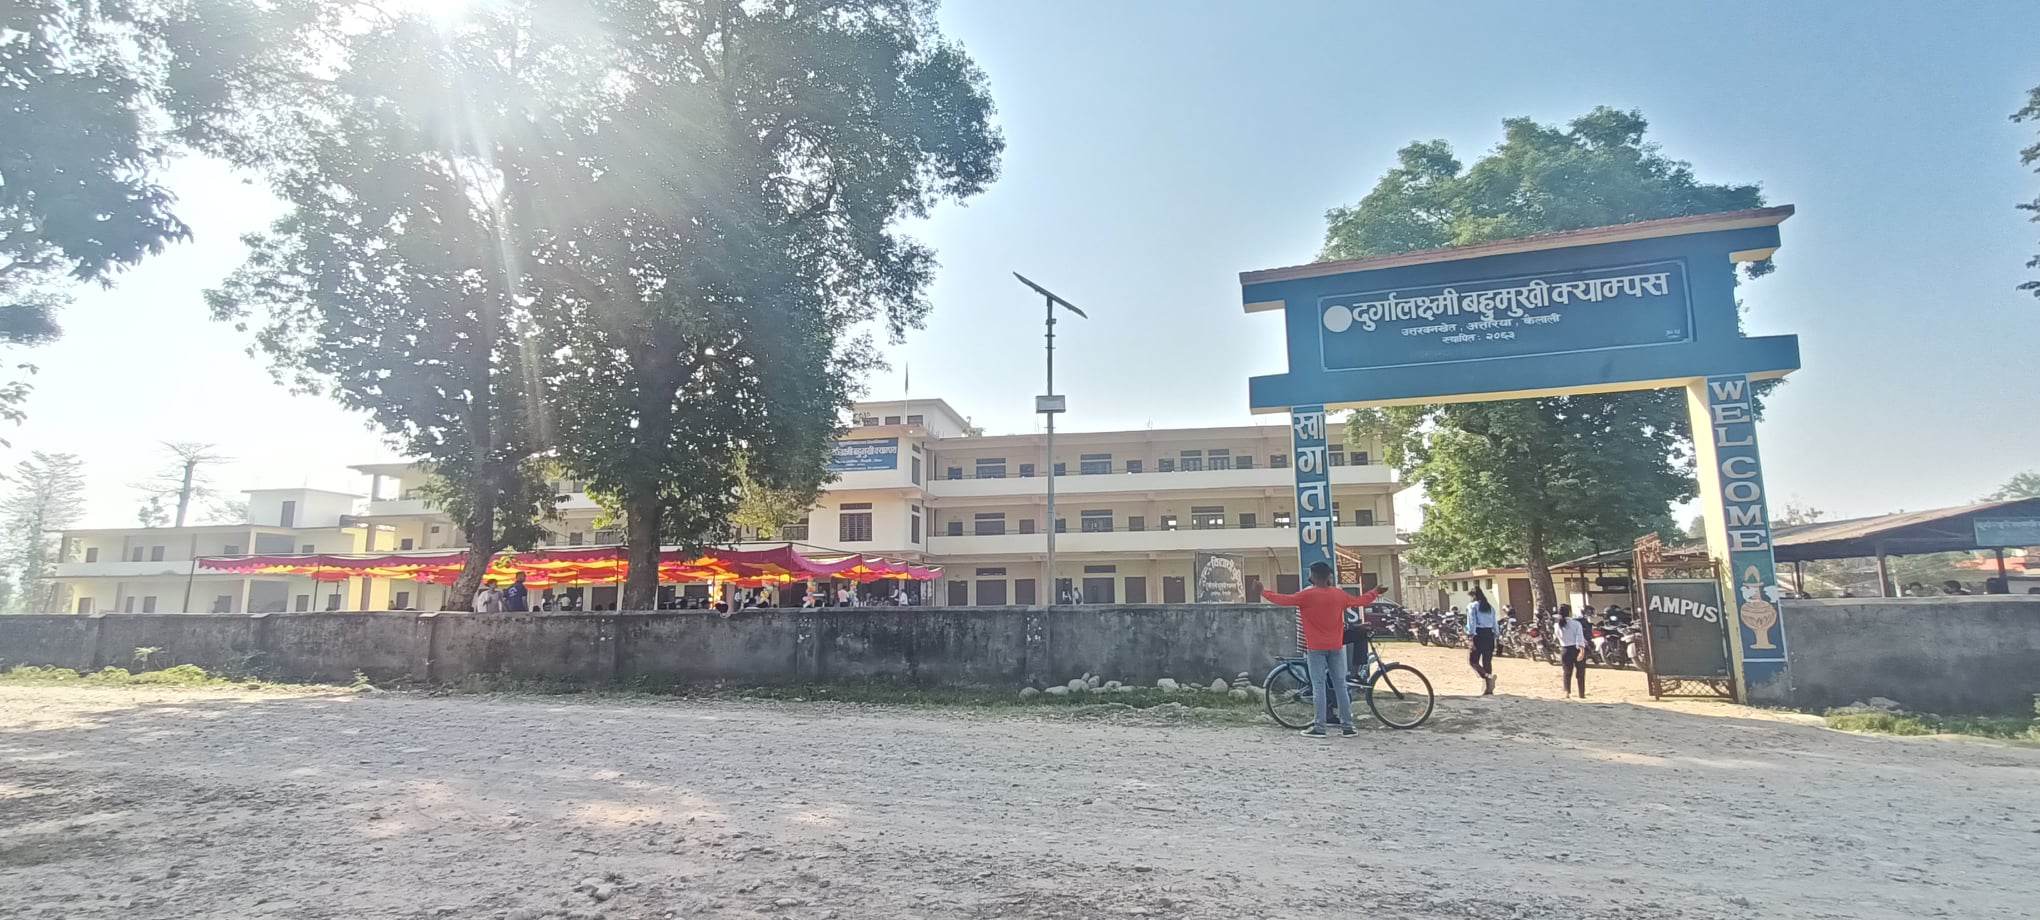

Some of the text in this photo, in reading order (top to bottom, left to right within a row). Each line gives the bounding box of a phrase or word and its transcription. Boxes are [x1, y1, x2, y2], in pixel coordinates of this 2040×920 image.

[1352, 272, 1671, 332] दुर्गालक्ष्मी बहुमुखी क्याम्पस
[1294, 413, 1331, 559] स्वागतम्
[1709, 380, 1768, 552] WELCOME
[1648, 595, 1719, 623] AMPUS
